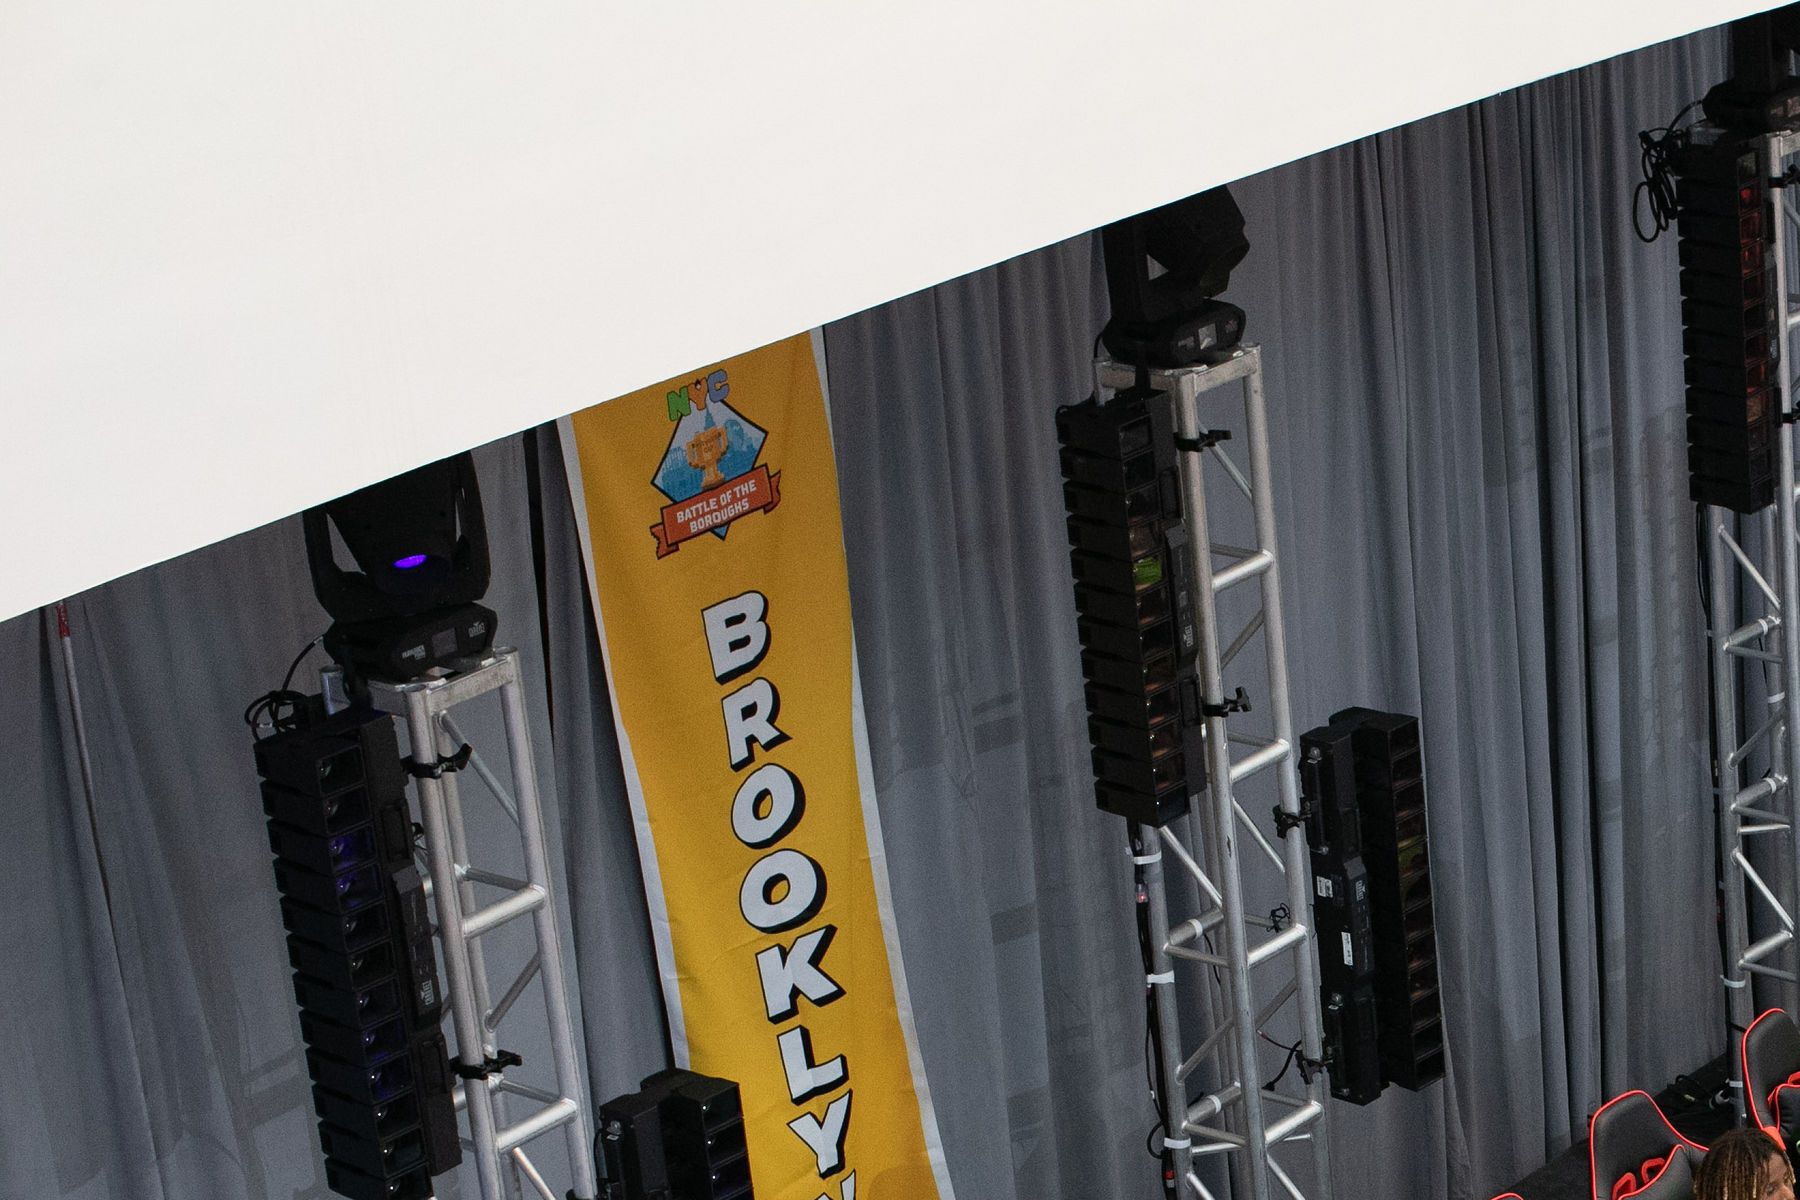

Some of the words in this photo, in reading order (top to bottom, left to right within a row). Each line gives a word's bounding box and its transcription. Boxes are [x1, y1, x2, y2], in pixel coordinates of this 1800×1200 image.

[667, 369, 730, 421] NYC
[676, 497, 718, 524] BATTLE
[720, 492, 735, 506] OF
[735, 480, 757, 499] THE
[690, 498, 750, 533] BOROUGHS
